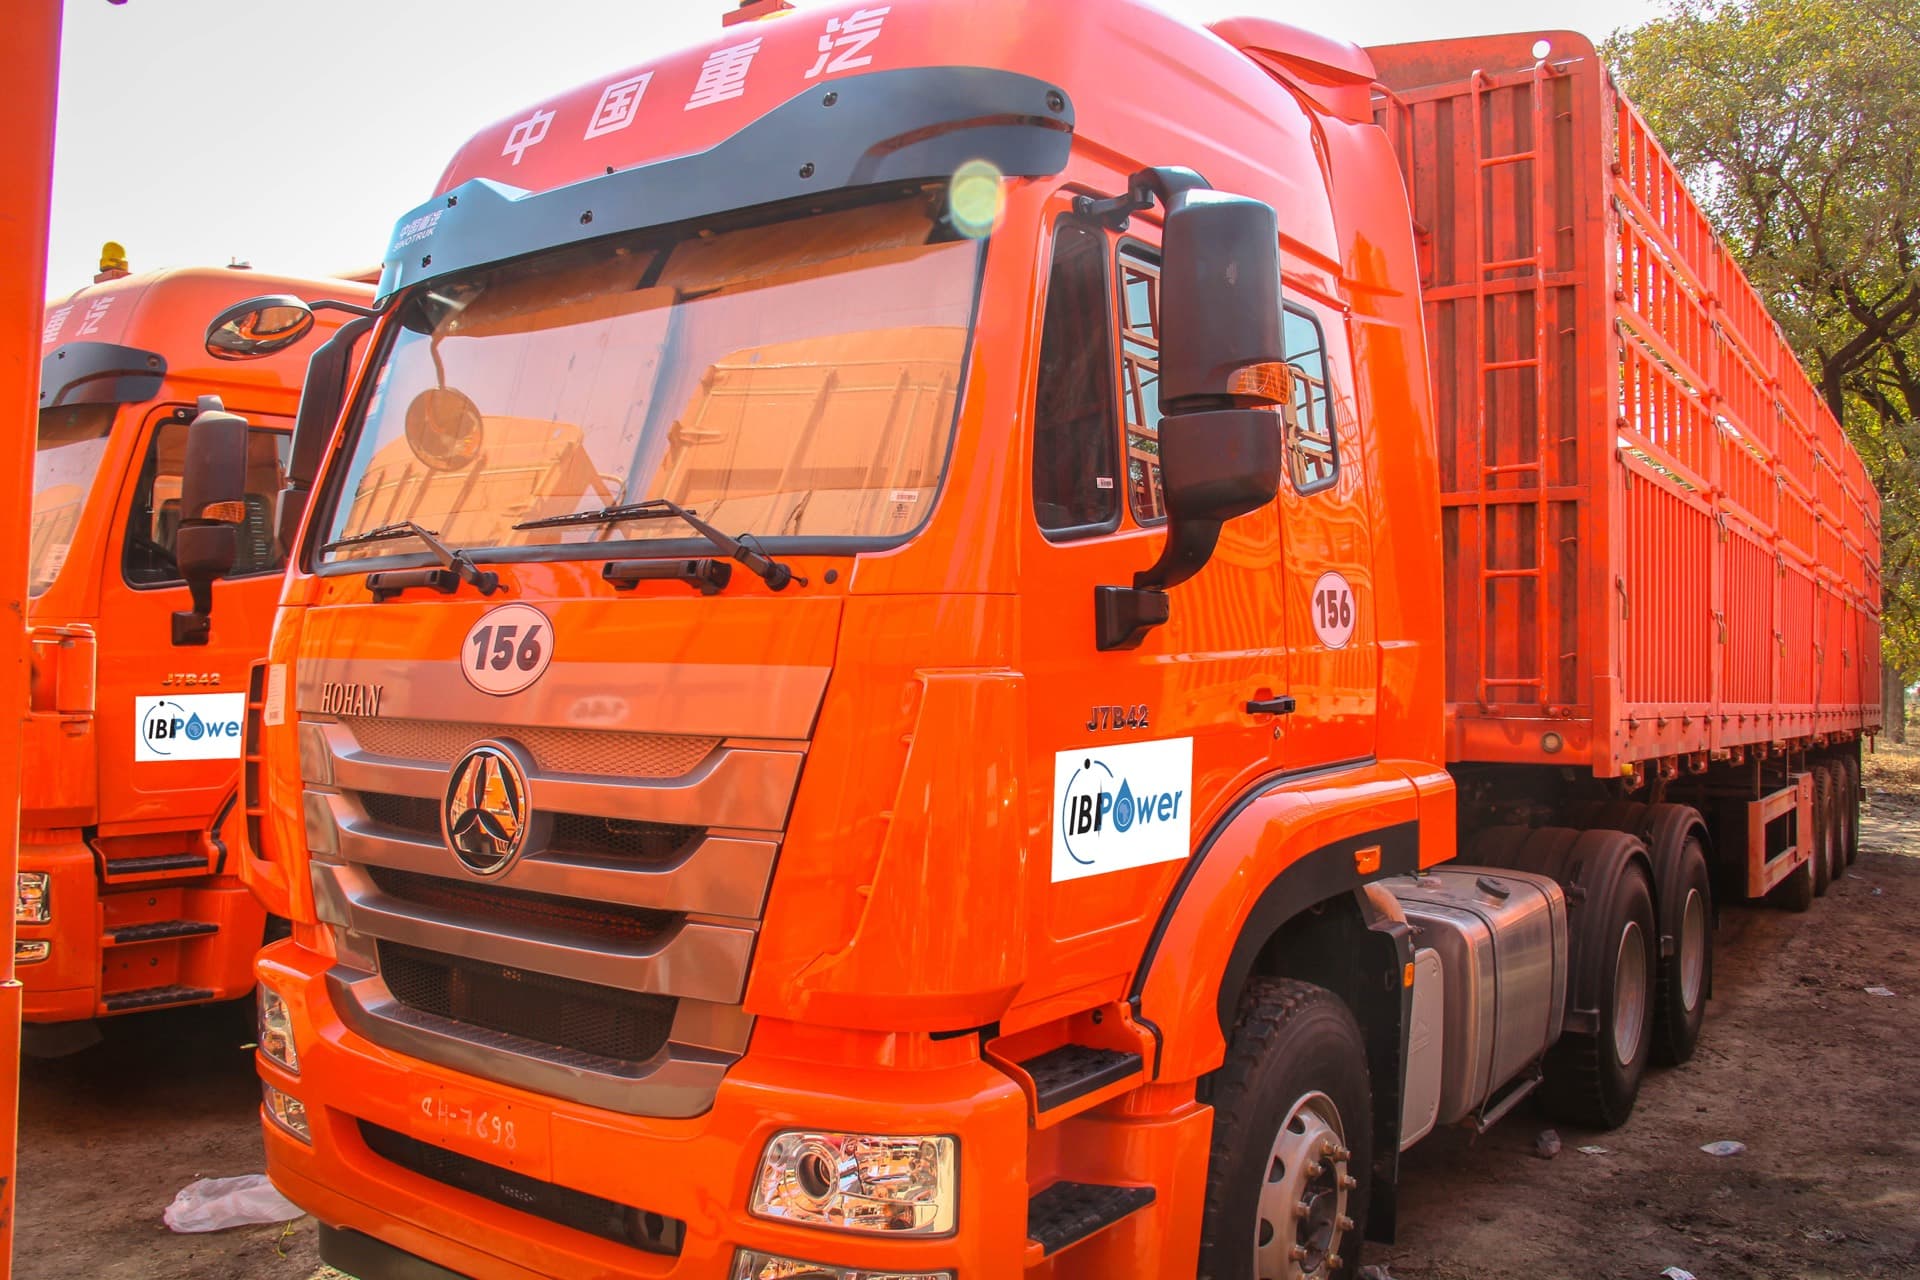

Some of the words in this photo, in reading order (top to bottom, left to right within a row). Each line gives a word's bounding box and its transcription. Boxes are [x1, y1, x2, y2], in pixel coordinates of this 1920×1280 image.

[502, 6, 891, 166] 中国重汽
[1315, 590, 1351, 629] 156
[472, 625, 543, 671] 156
[162, 672, 221, 686] J7B42
[320, 682, 384, 717] HOHAN
[1086, 704, 1149, 731] J7B42
